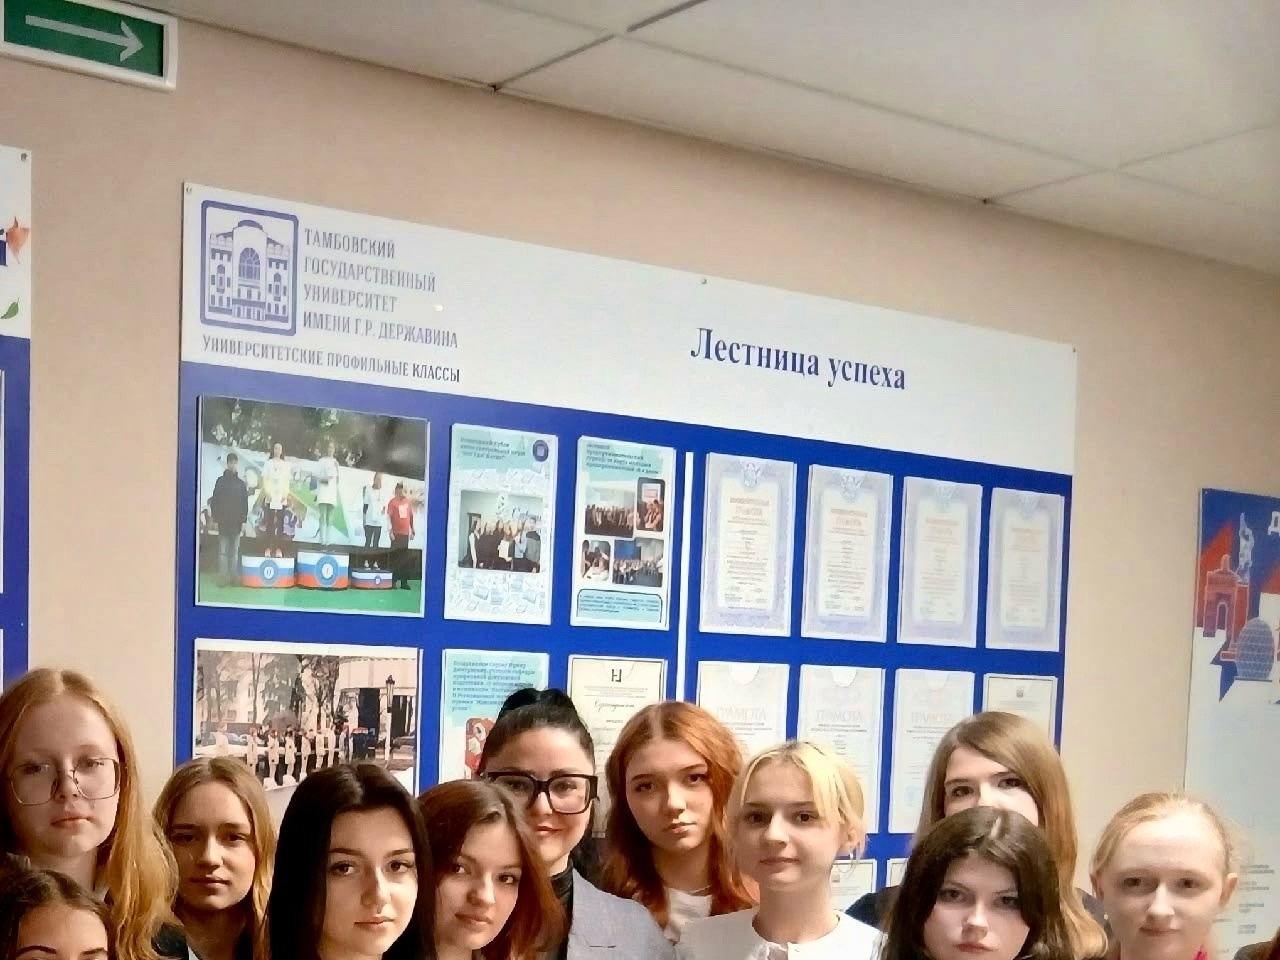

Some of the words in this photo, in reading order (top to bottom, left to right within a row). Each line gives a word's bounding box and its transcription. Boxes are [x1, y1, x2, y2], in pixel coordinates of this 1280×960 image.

[304, 228, 395, 259] ТАМБОВСКИЙ
[304, 257, 436, 292] ГОСУДАРСТВЕННЫЙ
[304, 284, 397, 313] УНИВЕРСИТЕТ
[303, 311, 350, 331] ИМЕНИ
[354, 319, 376, 338] Г.Р.
[378, 322, 458, 349] ДЕРЖАВИНА
[202, 335, 323, 366] УНИВЕРСИТЕТСКИЕ
[327, 352, 409, 378] ПРОФИЛЬНЫЕ
[412, 364, 460, 383] КЛАССЫ
[690, 327, 819, 378] Лестница
[827, 357, 905, 390] успеха
